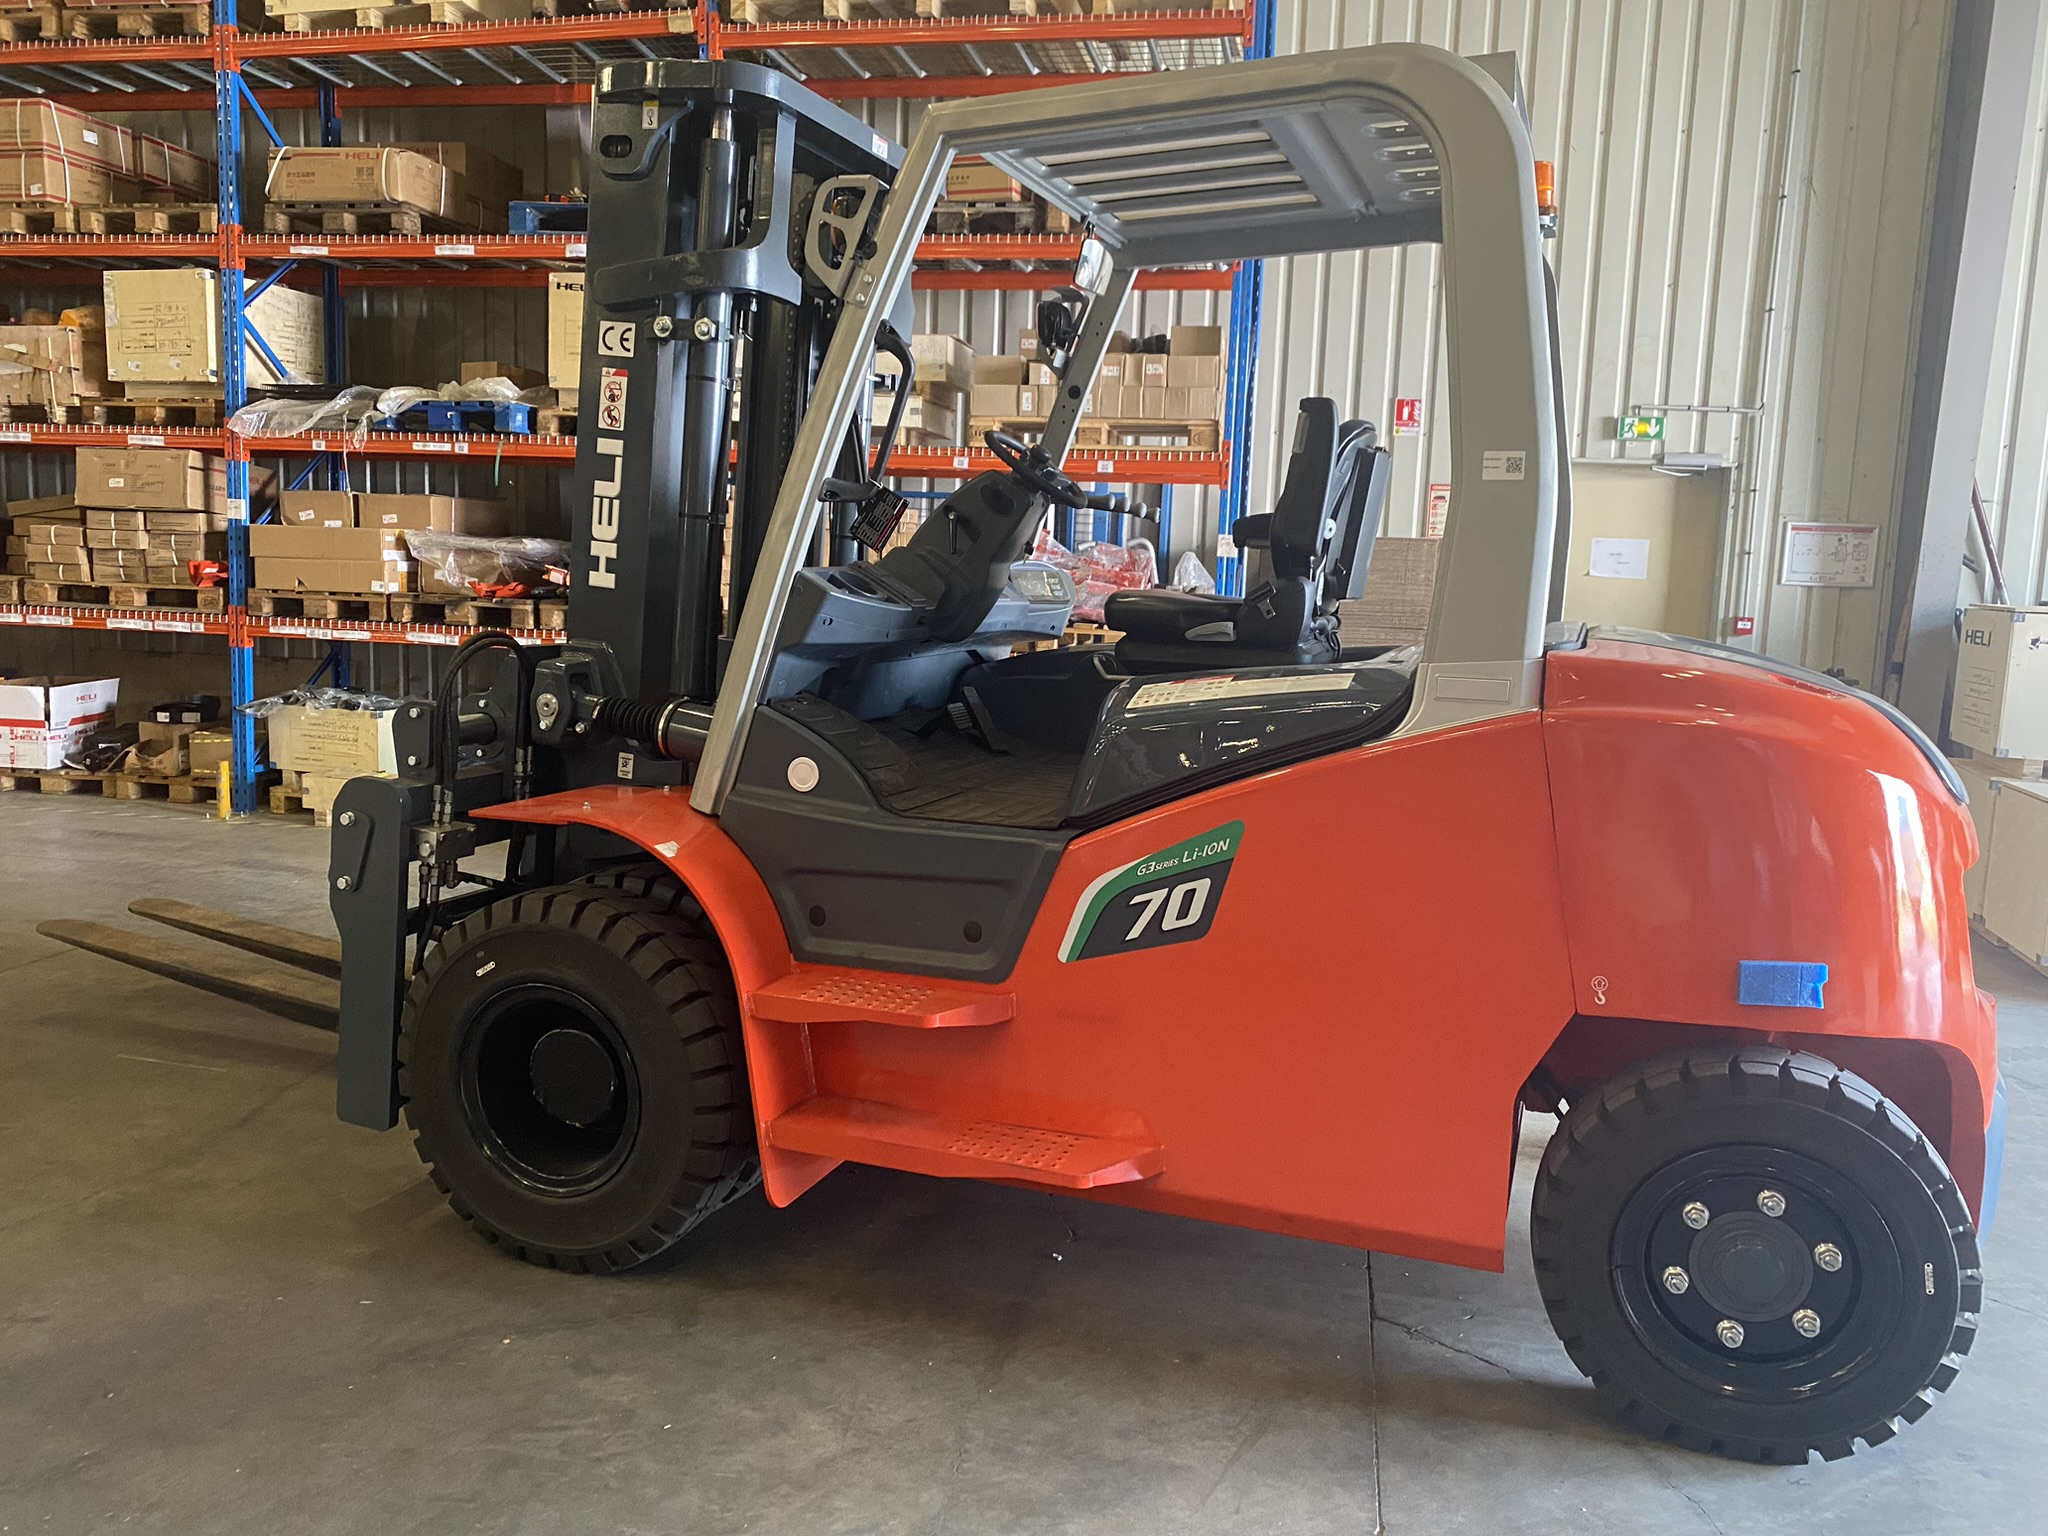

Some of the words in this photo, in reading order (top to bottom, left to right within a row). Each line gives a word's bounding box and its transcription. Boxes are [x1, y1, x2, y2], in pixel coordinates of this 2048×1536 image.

[345, 152, 380, 160] HELI
[588, 437, 624, 589] HELI
[1964, 629, 1992, 647] HELI
[76, 693, 97, 702] HELI
[1182, 838, 1231, 863] Li-ION
[1124, 877, 1212, 941] 70
